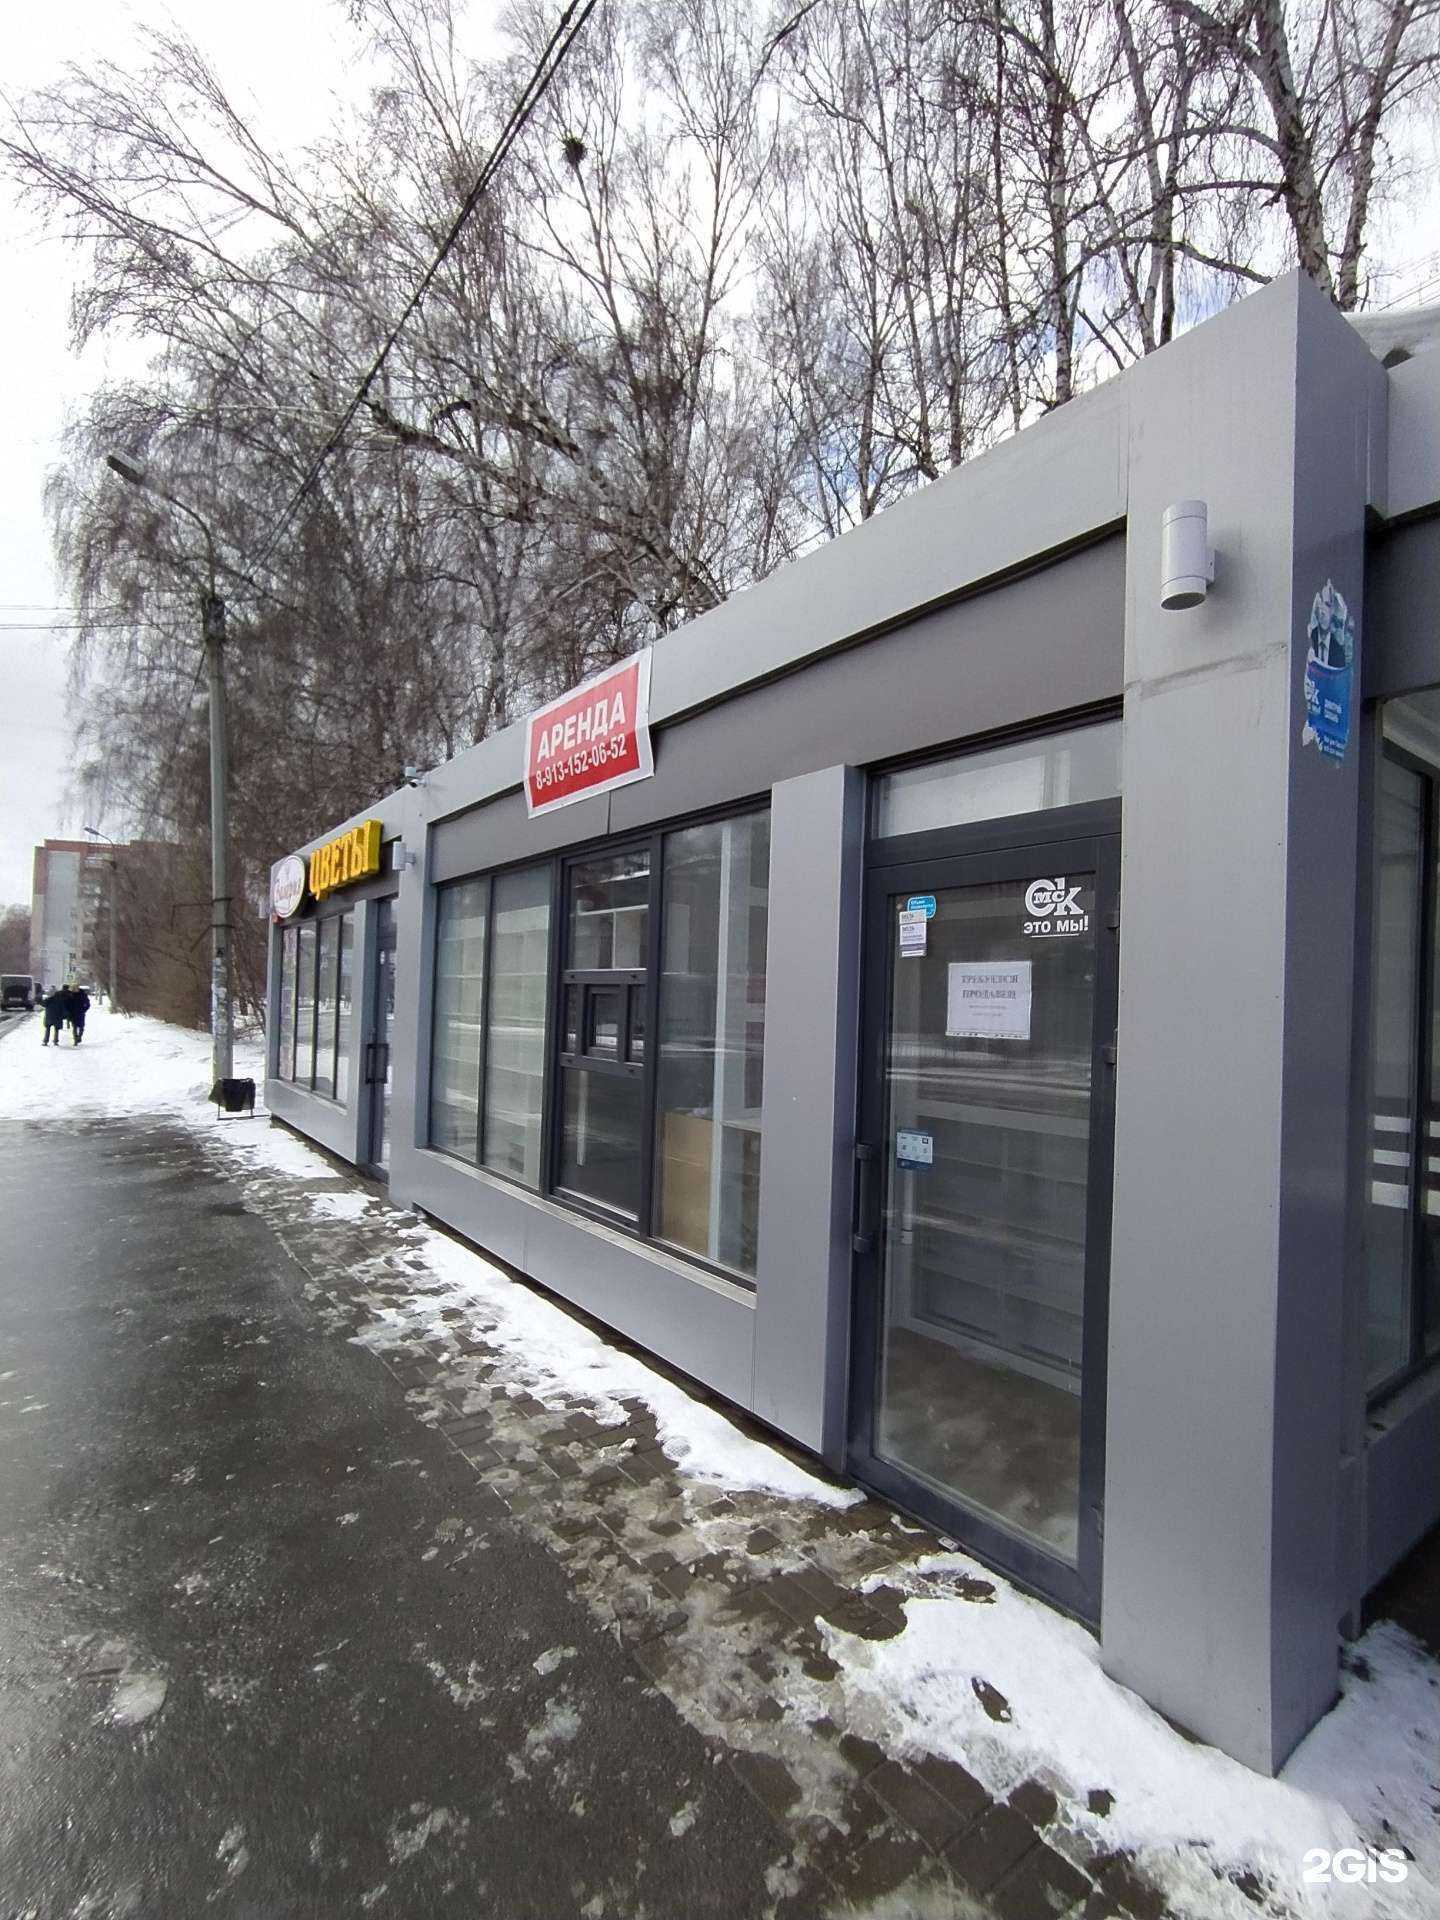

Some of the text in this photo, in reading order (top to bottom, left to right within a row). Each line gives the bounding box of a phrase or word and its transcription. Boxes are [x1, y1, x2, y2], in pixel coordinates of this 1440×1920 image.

[535, 733, 627, 790] 8-913-152-06-52
[537, 691, 626, 763] АРЕНДА
[309, 819, 384, 901] ЦВЕТЫ
